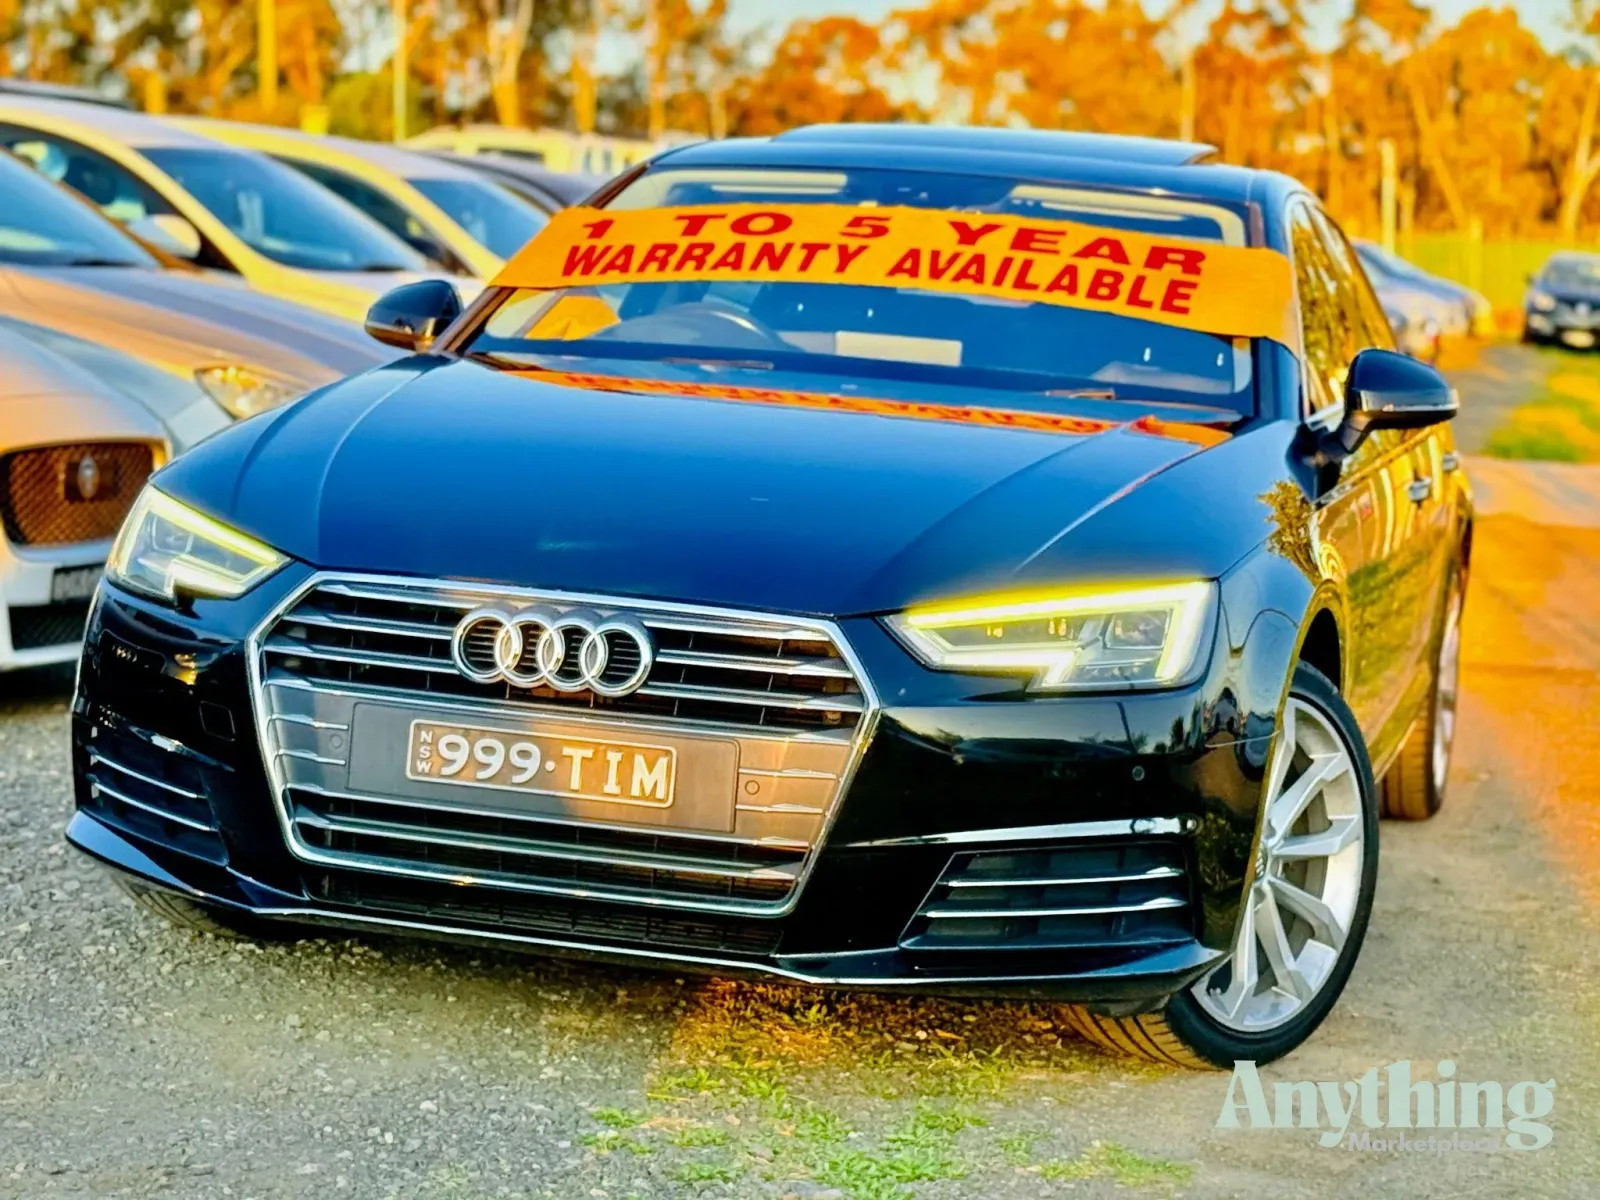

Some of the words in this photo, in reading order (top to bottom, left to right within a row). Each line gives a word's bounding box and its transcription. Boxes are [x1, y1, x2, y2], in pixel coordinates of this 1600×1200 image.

[562, 242, 869, 277] WARRANTY
[887, 248, 1199, 315] AVAILABLE
[584, 217, 615, 240] 1
[675, 214, 793, 237] TO
[841, 215, 889, 239] 5
[949, 220, 1207, 277] YEAR
